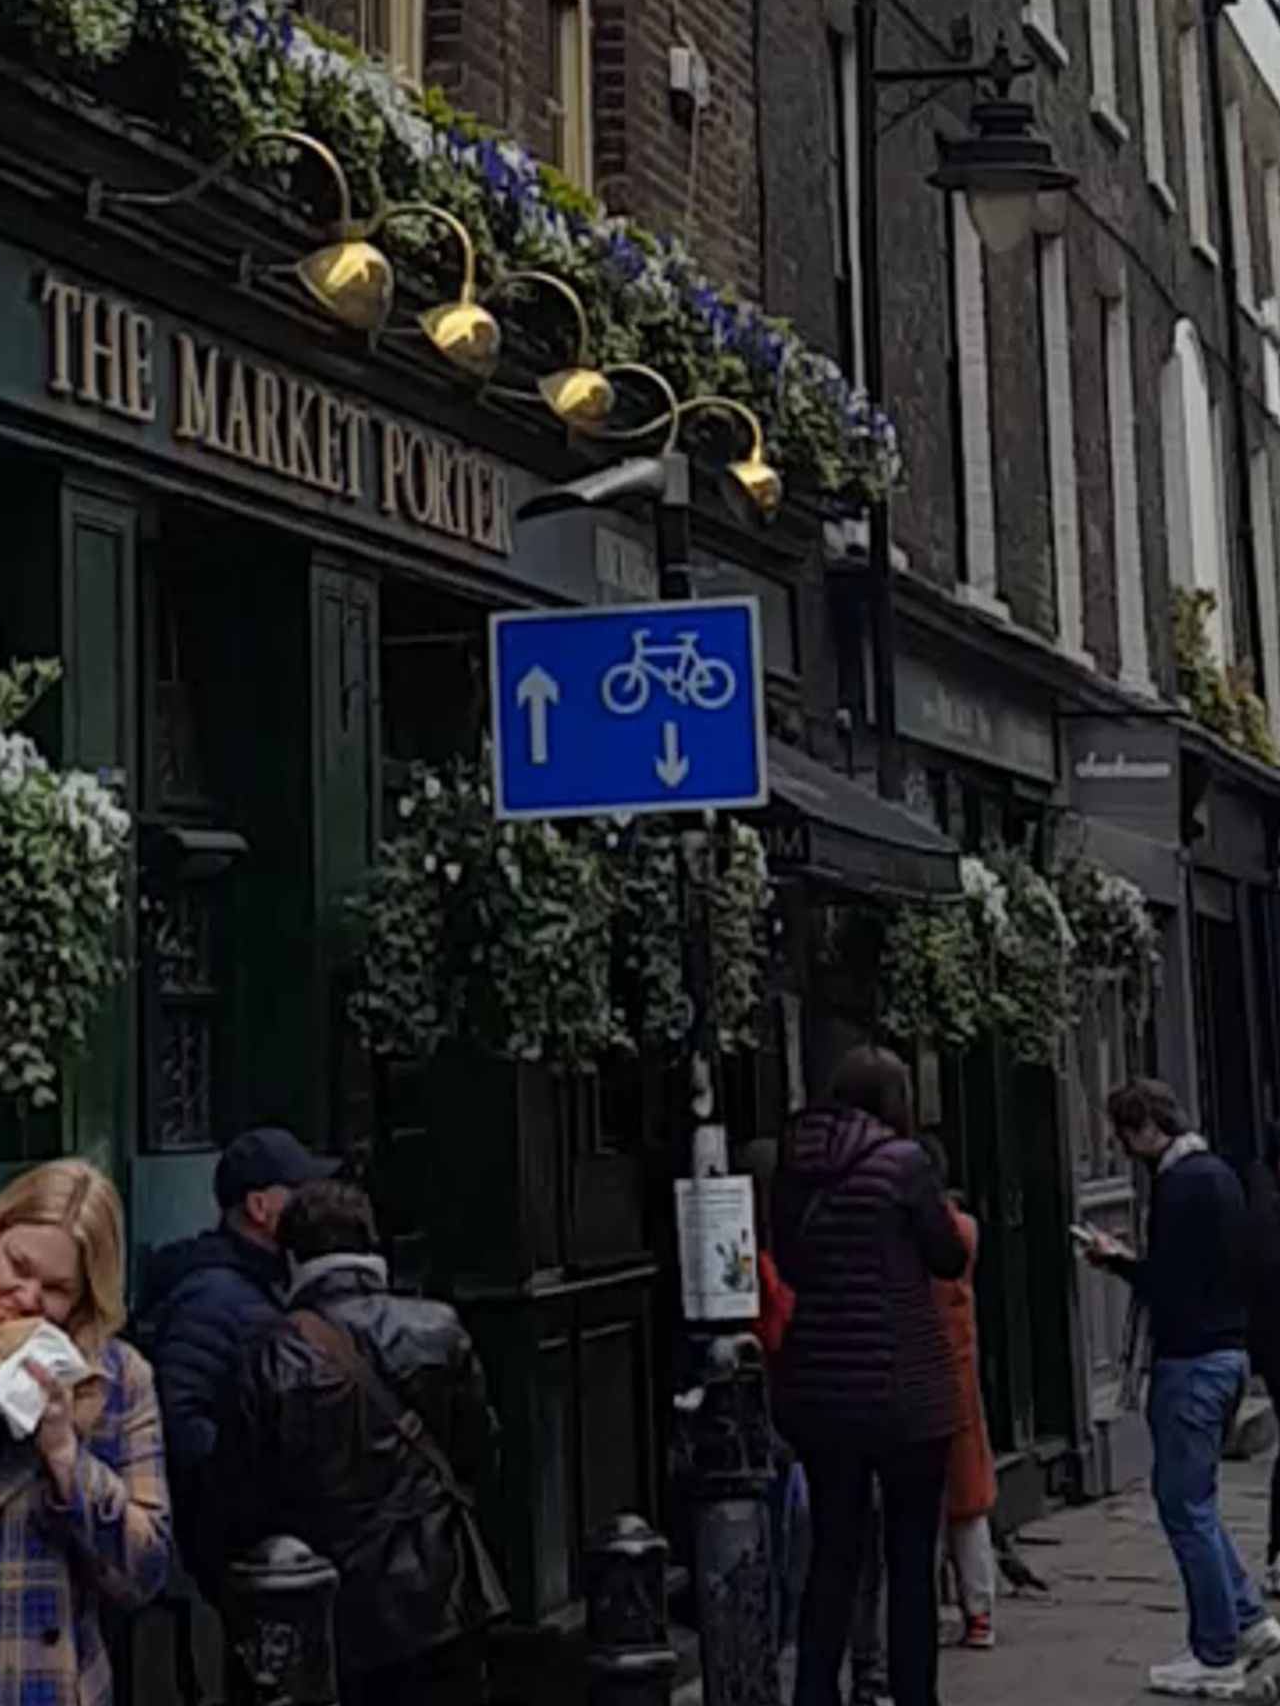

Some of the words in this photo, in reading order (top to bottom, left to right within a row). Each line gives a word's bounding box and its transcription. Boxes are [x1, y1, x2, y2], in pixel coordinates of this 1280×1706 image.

[40, 275, 156, 423] THE
[175, 329, 371, 499] MARKET
[380, 419, 514, 556] PORTER
